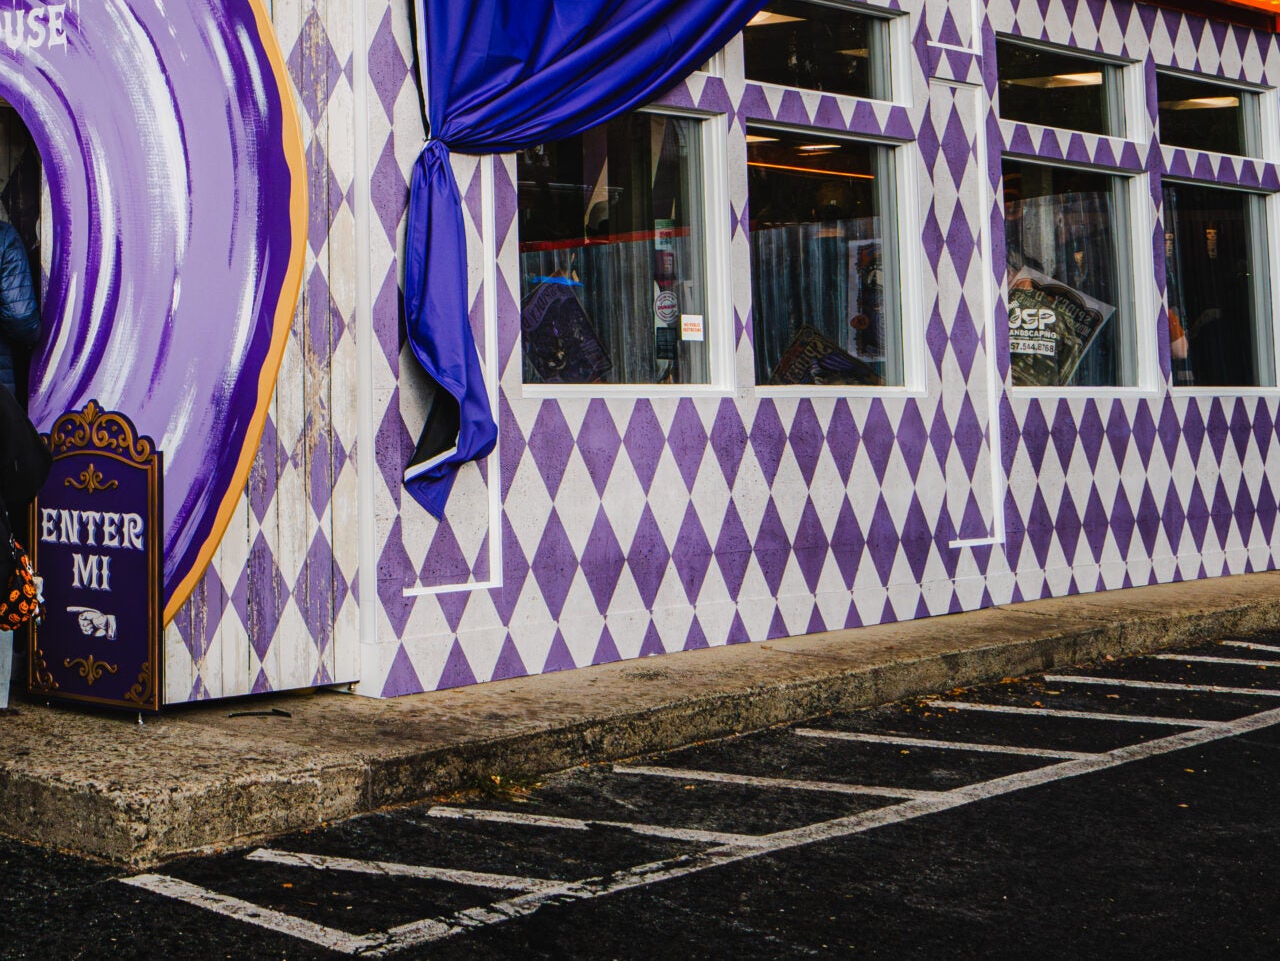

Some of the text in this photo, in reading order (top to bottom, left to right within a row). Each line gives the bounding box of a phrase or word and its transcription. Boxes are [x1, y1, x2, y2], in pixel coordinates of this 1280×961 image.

[1008, 306, 1056, 330] JSP
[1008, 329, 1057, 339] ANDSCAPING
[41, 508, 144, 550] ENTER
[72, 553, 111, 591] MI
